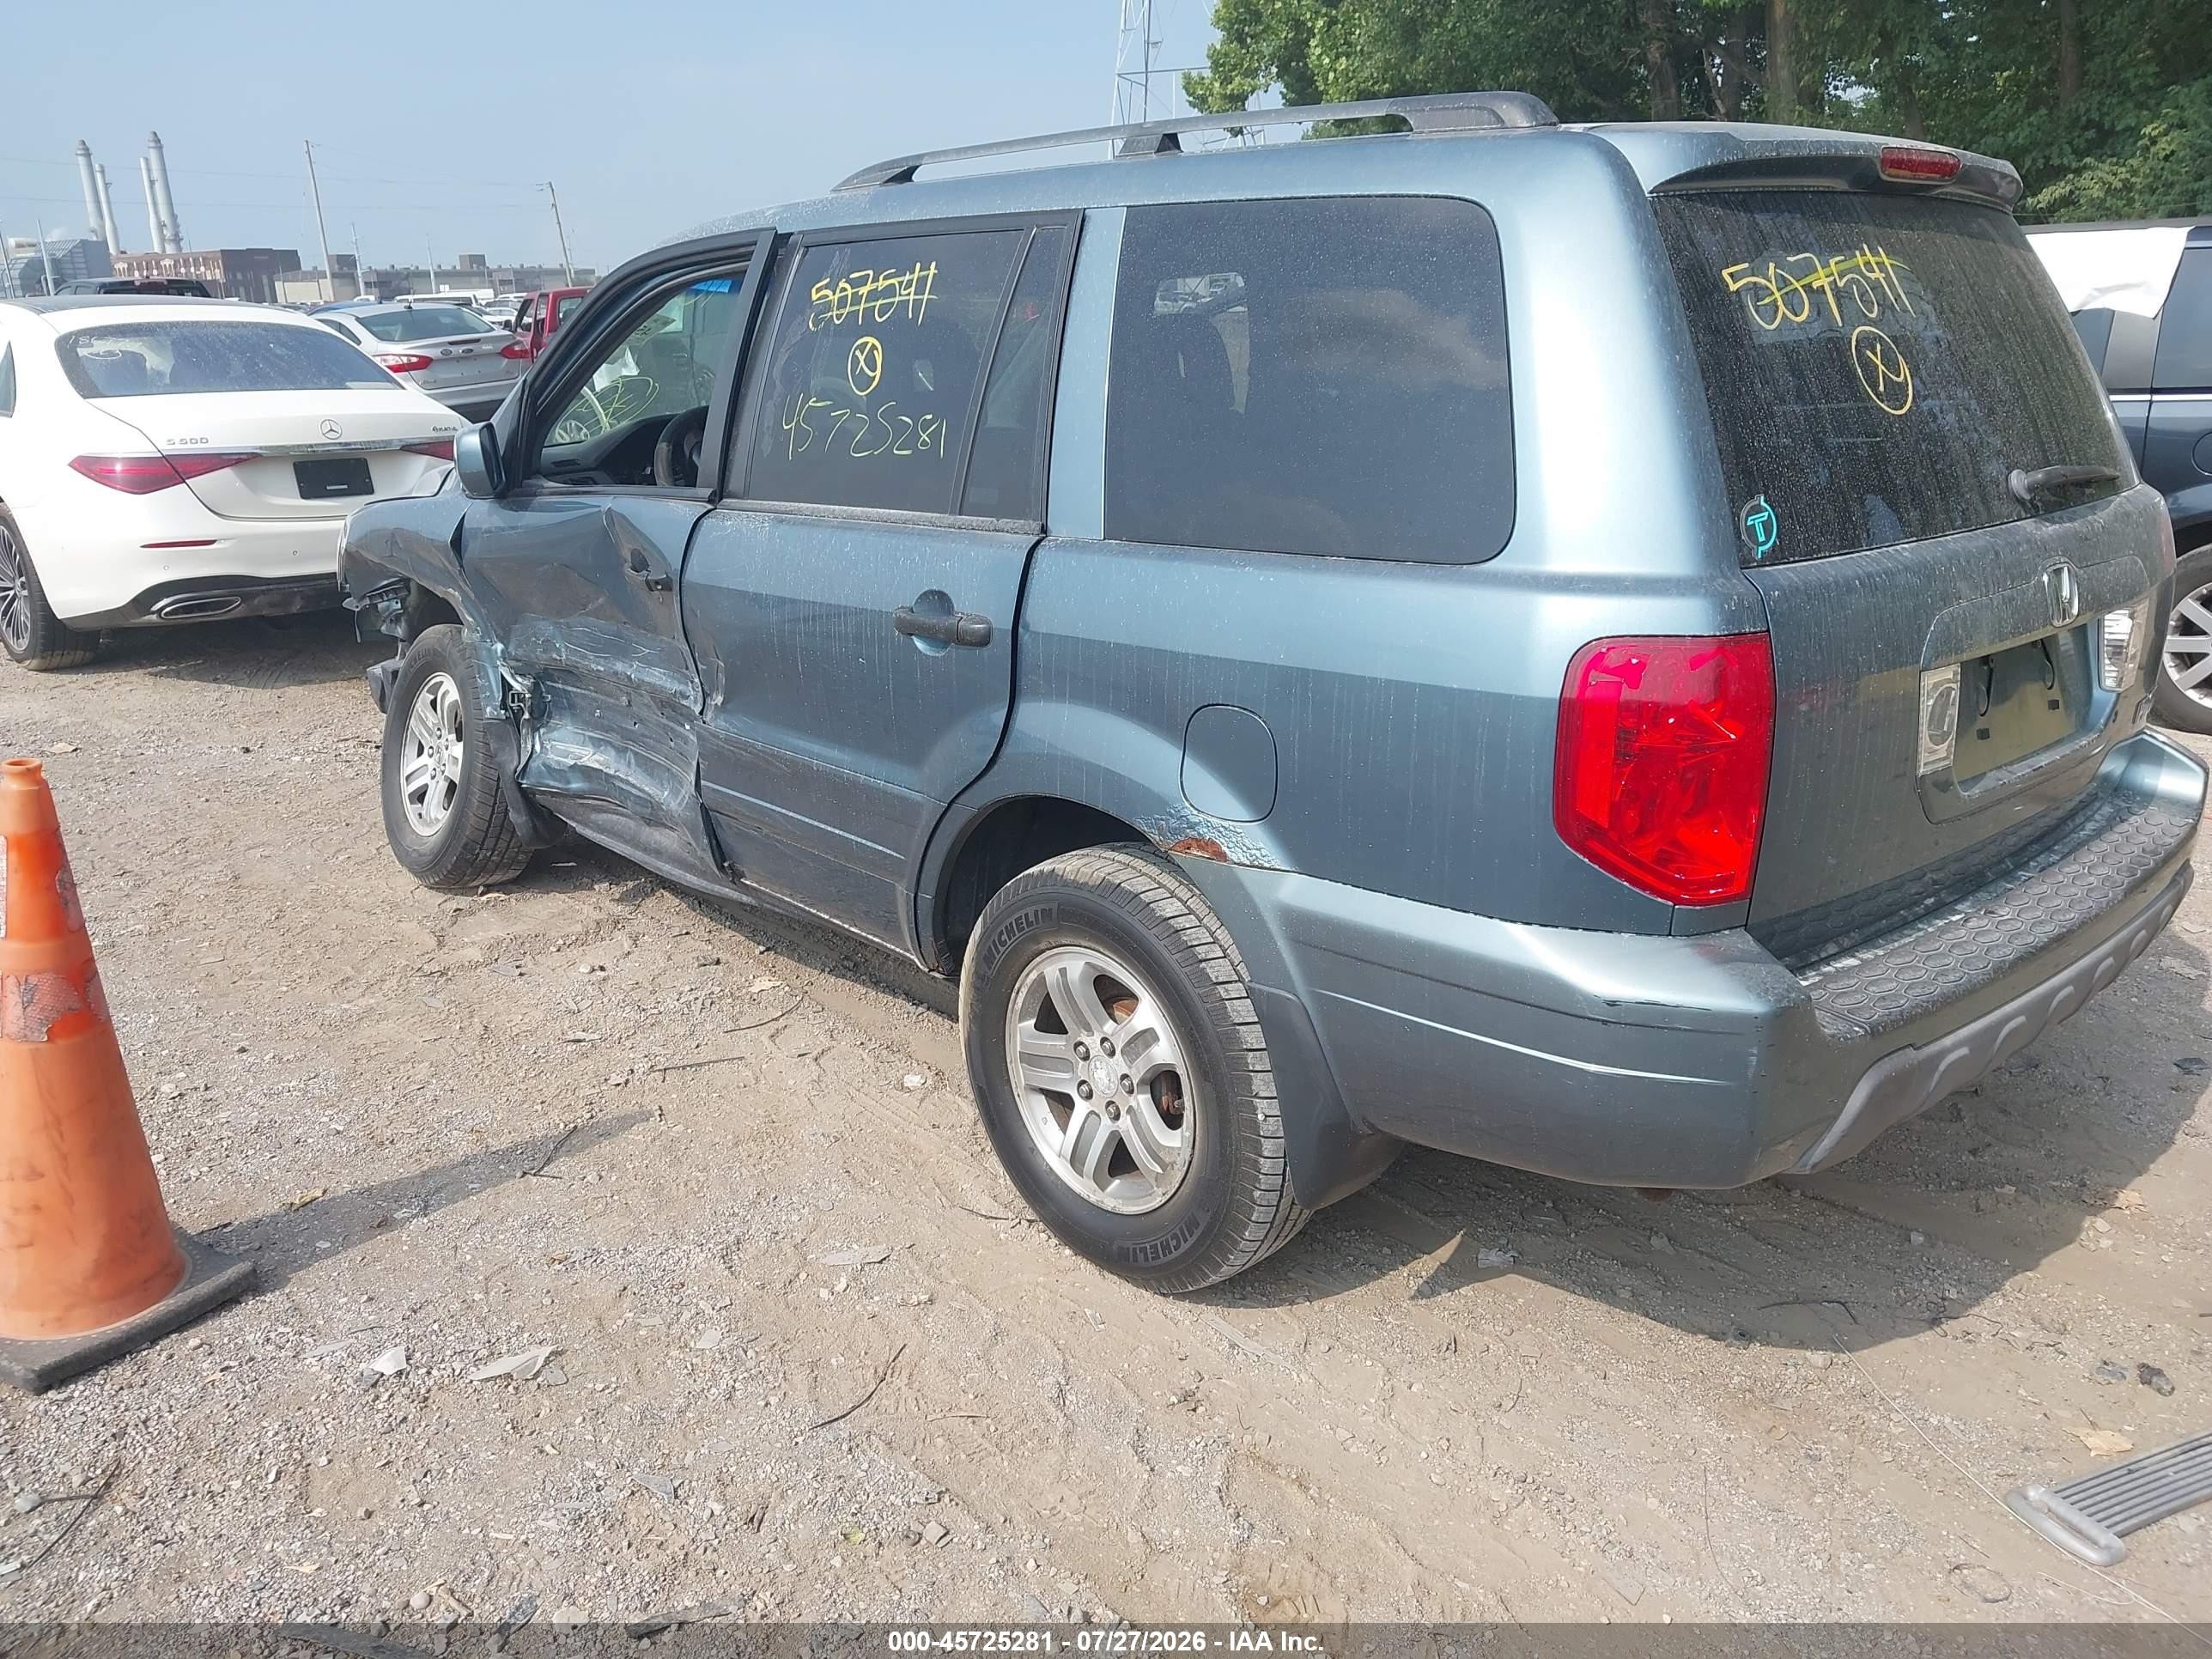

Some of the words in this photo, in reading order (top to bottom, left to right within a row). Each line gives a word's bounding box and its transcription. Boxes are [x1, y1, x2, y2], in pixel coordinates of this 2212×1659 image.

[808, 260, 937, 331] 507541
[1721, 243, 1917, 331] 507541
[782, 392, 947, 461] 45725281
[982, 907, 1054, 967] MICHELIN
[1116, 1211, 1201, 1264] MICHELIN
